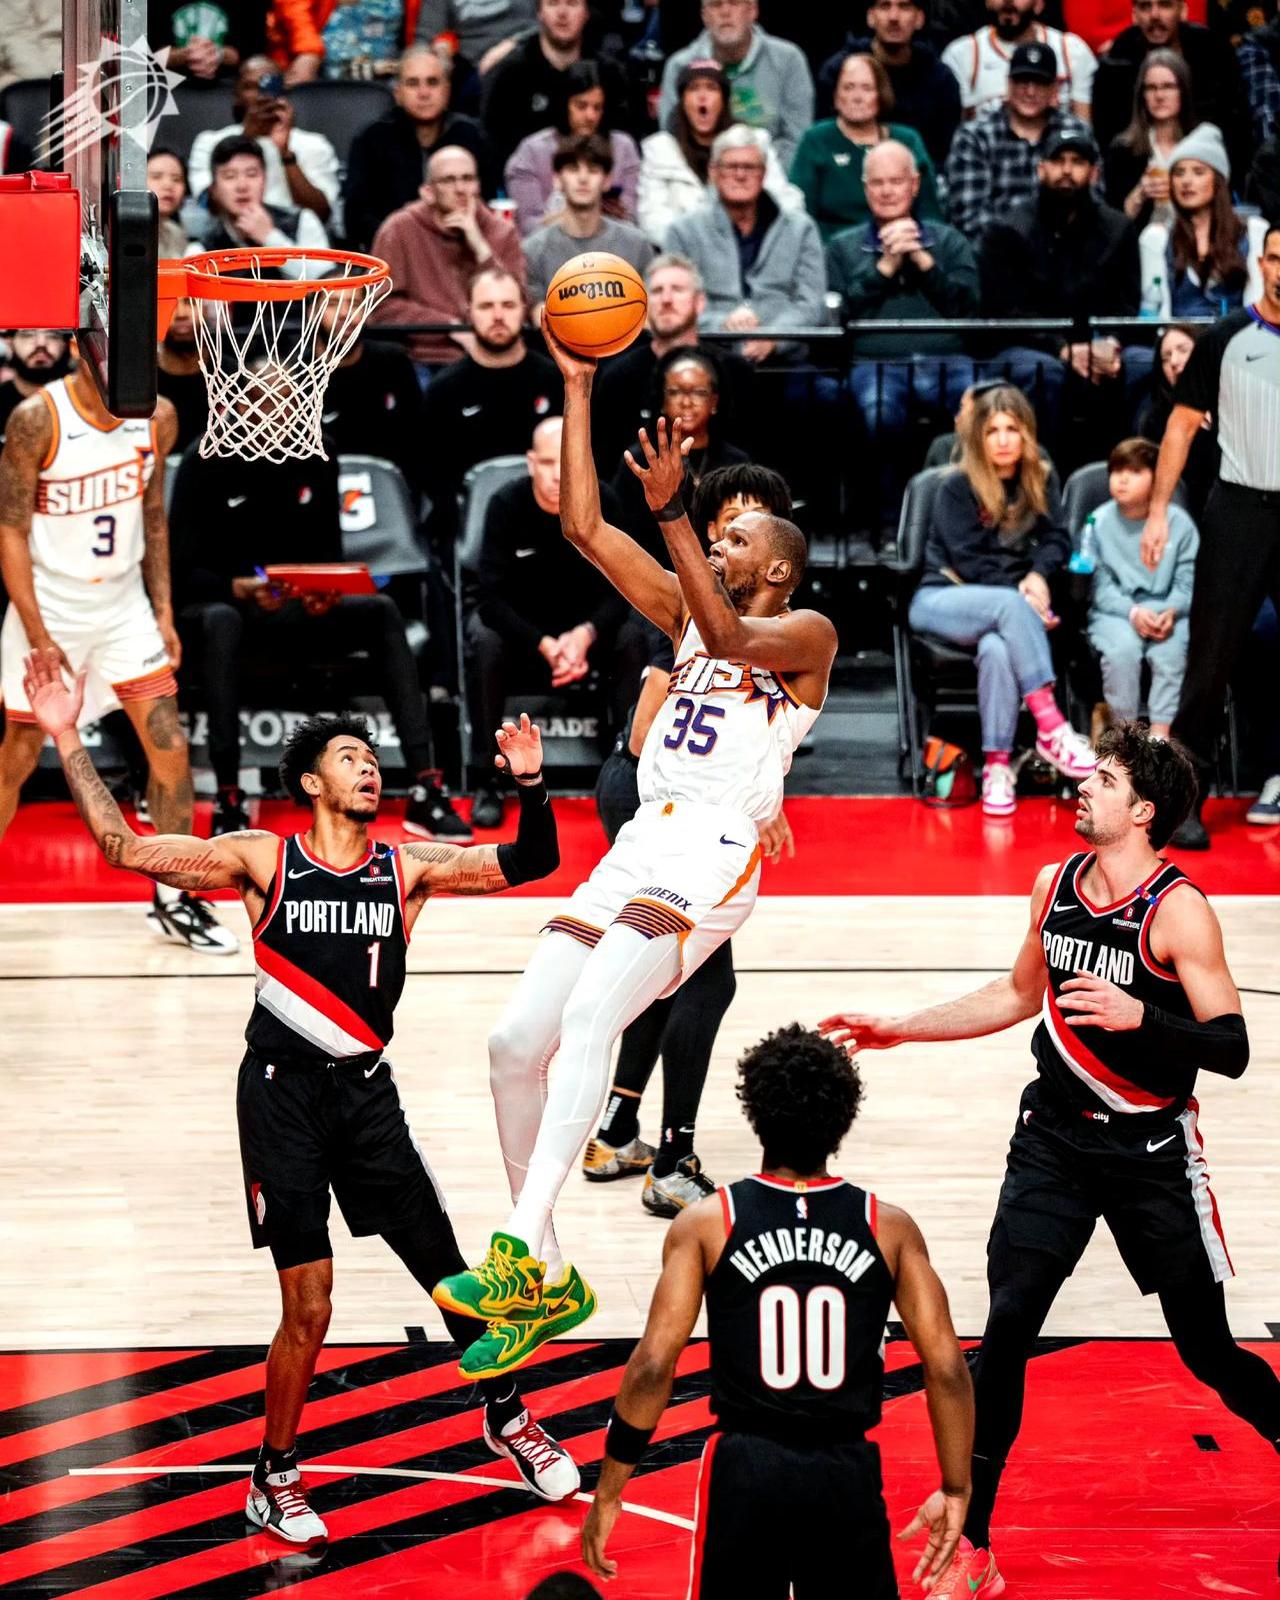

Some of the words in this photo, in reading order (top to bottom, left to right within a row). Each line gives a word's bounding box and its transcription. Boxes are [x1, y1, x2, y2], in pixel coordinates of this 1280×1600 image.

[558, 280, 626, 301] Wilson
[92, 515, 116, 557] 3
[663, 697, 726, 755] 35
[284, 900, 395, 937] PORTLAND
[367, 942, 381, 987] 1
[1043, 930, 1135, 985] PORTLAND
[729, 1227, 876, 1283] HENDERSON
[760, 1285, 846, 1389] 00
